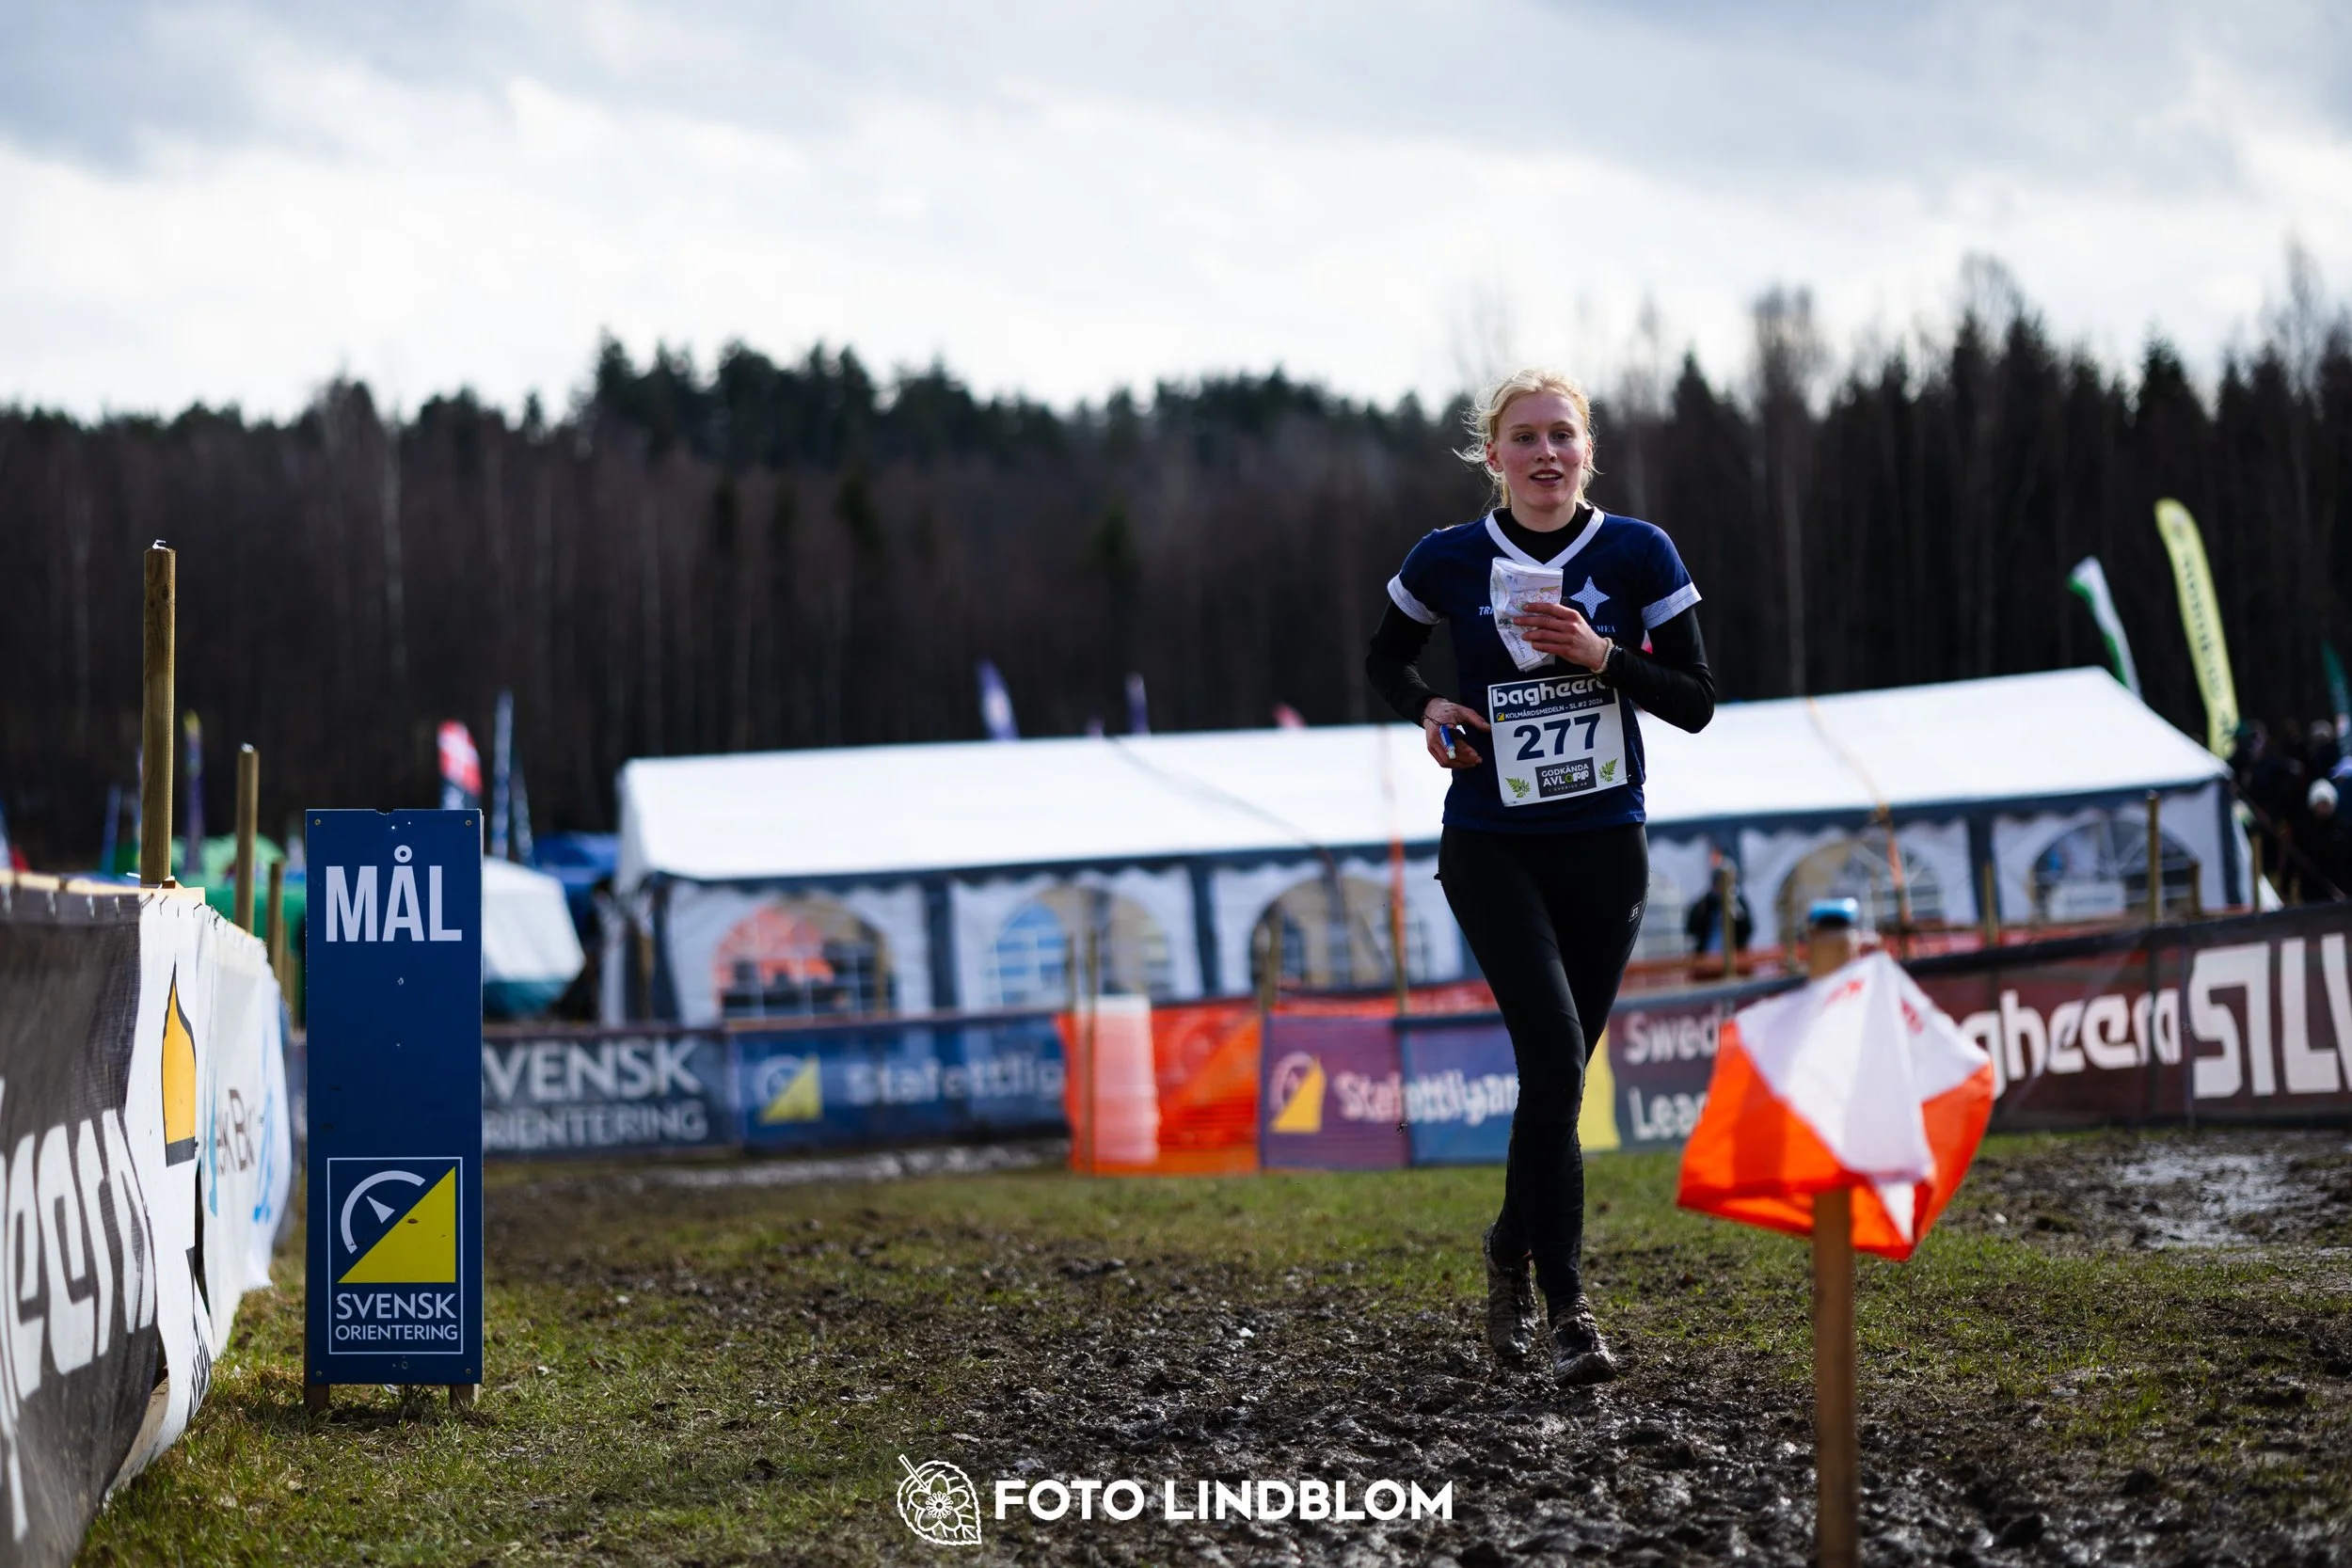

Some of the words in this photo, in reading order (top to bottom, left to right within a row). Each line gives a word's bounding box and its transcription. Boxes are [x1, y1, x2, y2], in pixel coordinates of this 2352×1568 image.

[1504, 705, 1565, 720] KOLMÅRDSMEDELN
[1588, 697, 1604, 706] 2026
[1513, 712, 1601, 761] 277
[1541, 763, 1590, 778] GODKÄNDA
[326, 845, 463, 942] MÅL
[482, 1036, 702, 1103] VENSK
[336, 1292, 457, 1320] SVENSK
[335, 1324, 458, 1341] ORIENTERING
